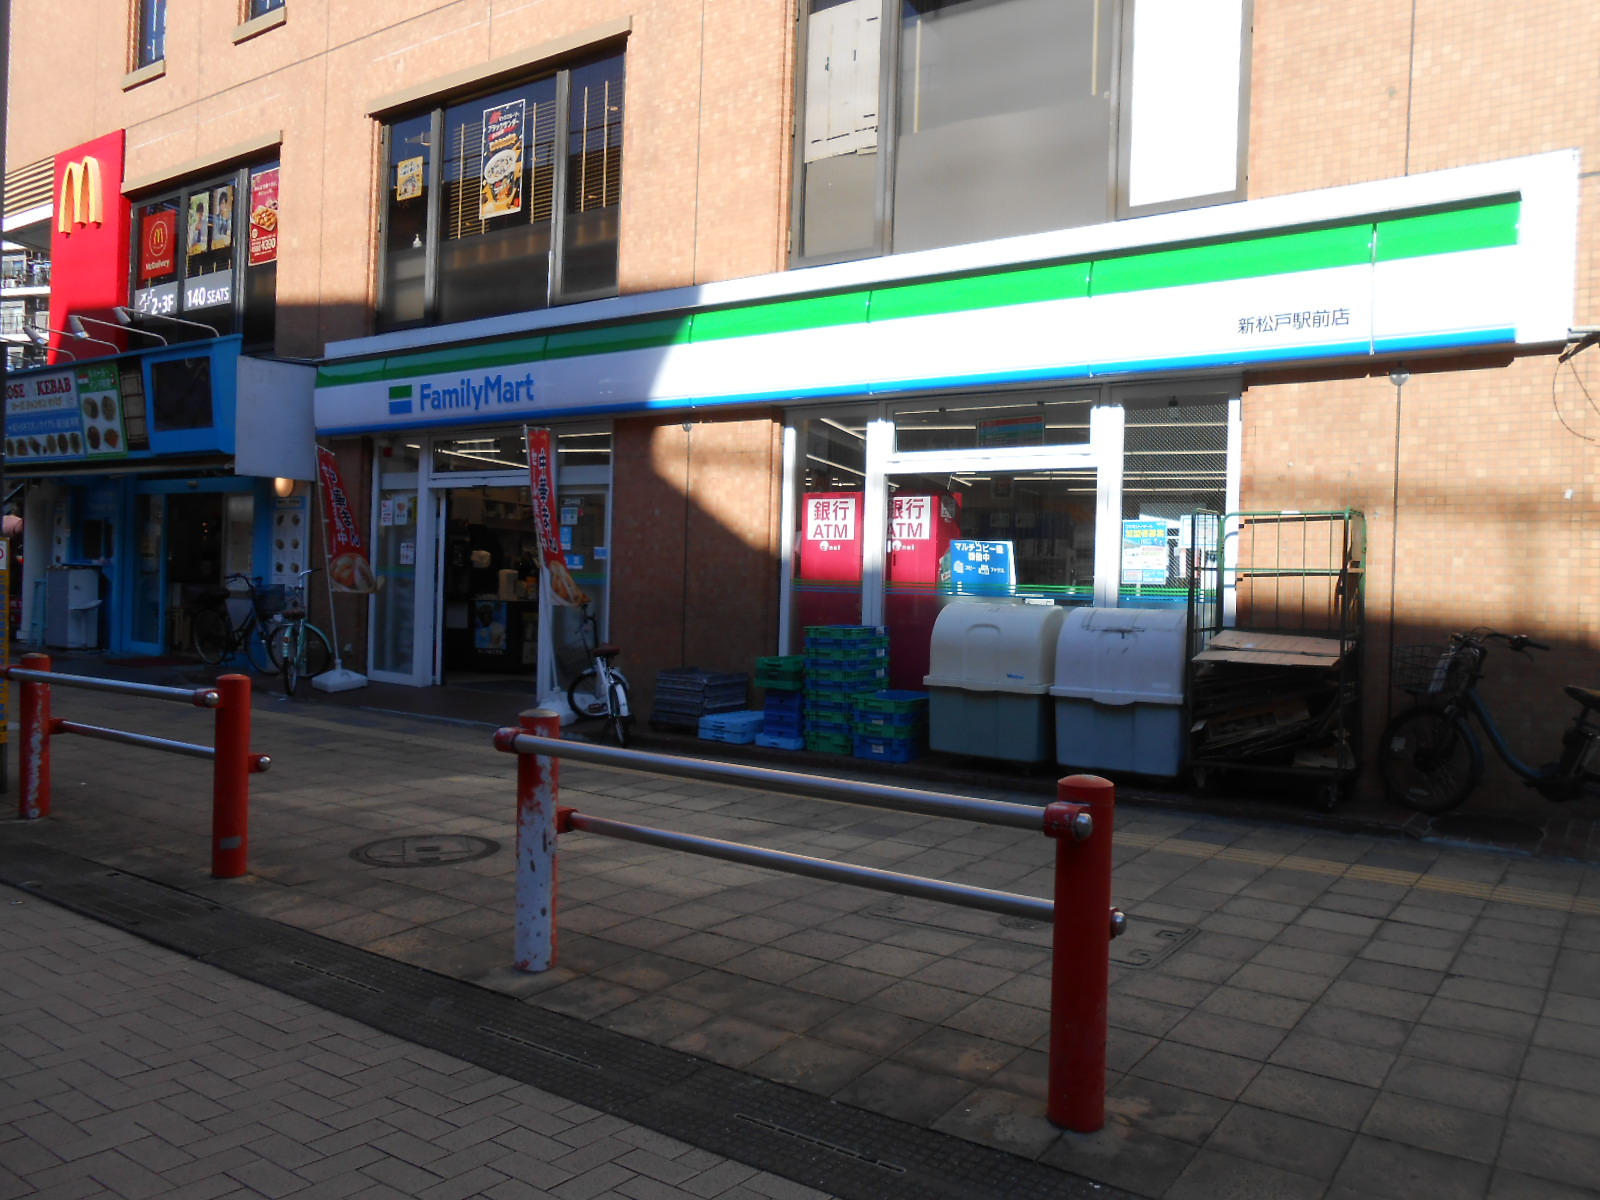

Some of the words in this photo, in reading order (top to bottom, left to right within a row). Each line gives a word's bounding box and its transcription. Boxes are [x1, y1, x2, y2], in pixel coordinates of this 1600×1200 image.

[187, 286, 206, 307] 140
[206, 287, 230, 302] SEATS
[1237, 308, 1350, 335] 新松戸駅前店
[36, 377, 72, 396] KEBAB
[420, 372, 534, 411] FamilyMart
[813, 500, 850, 521] 銀行
[813, 523, 848, 539] ATM
[887, 522, 923, 538] ATM
